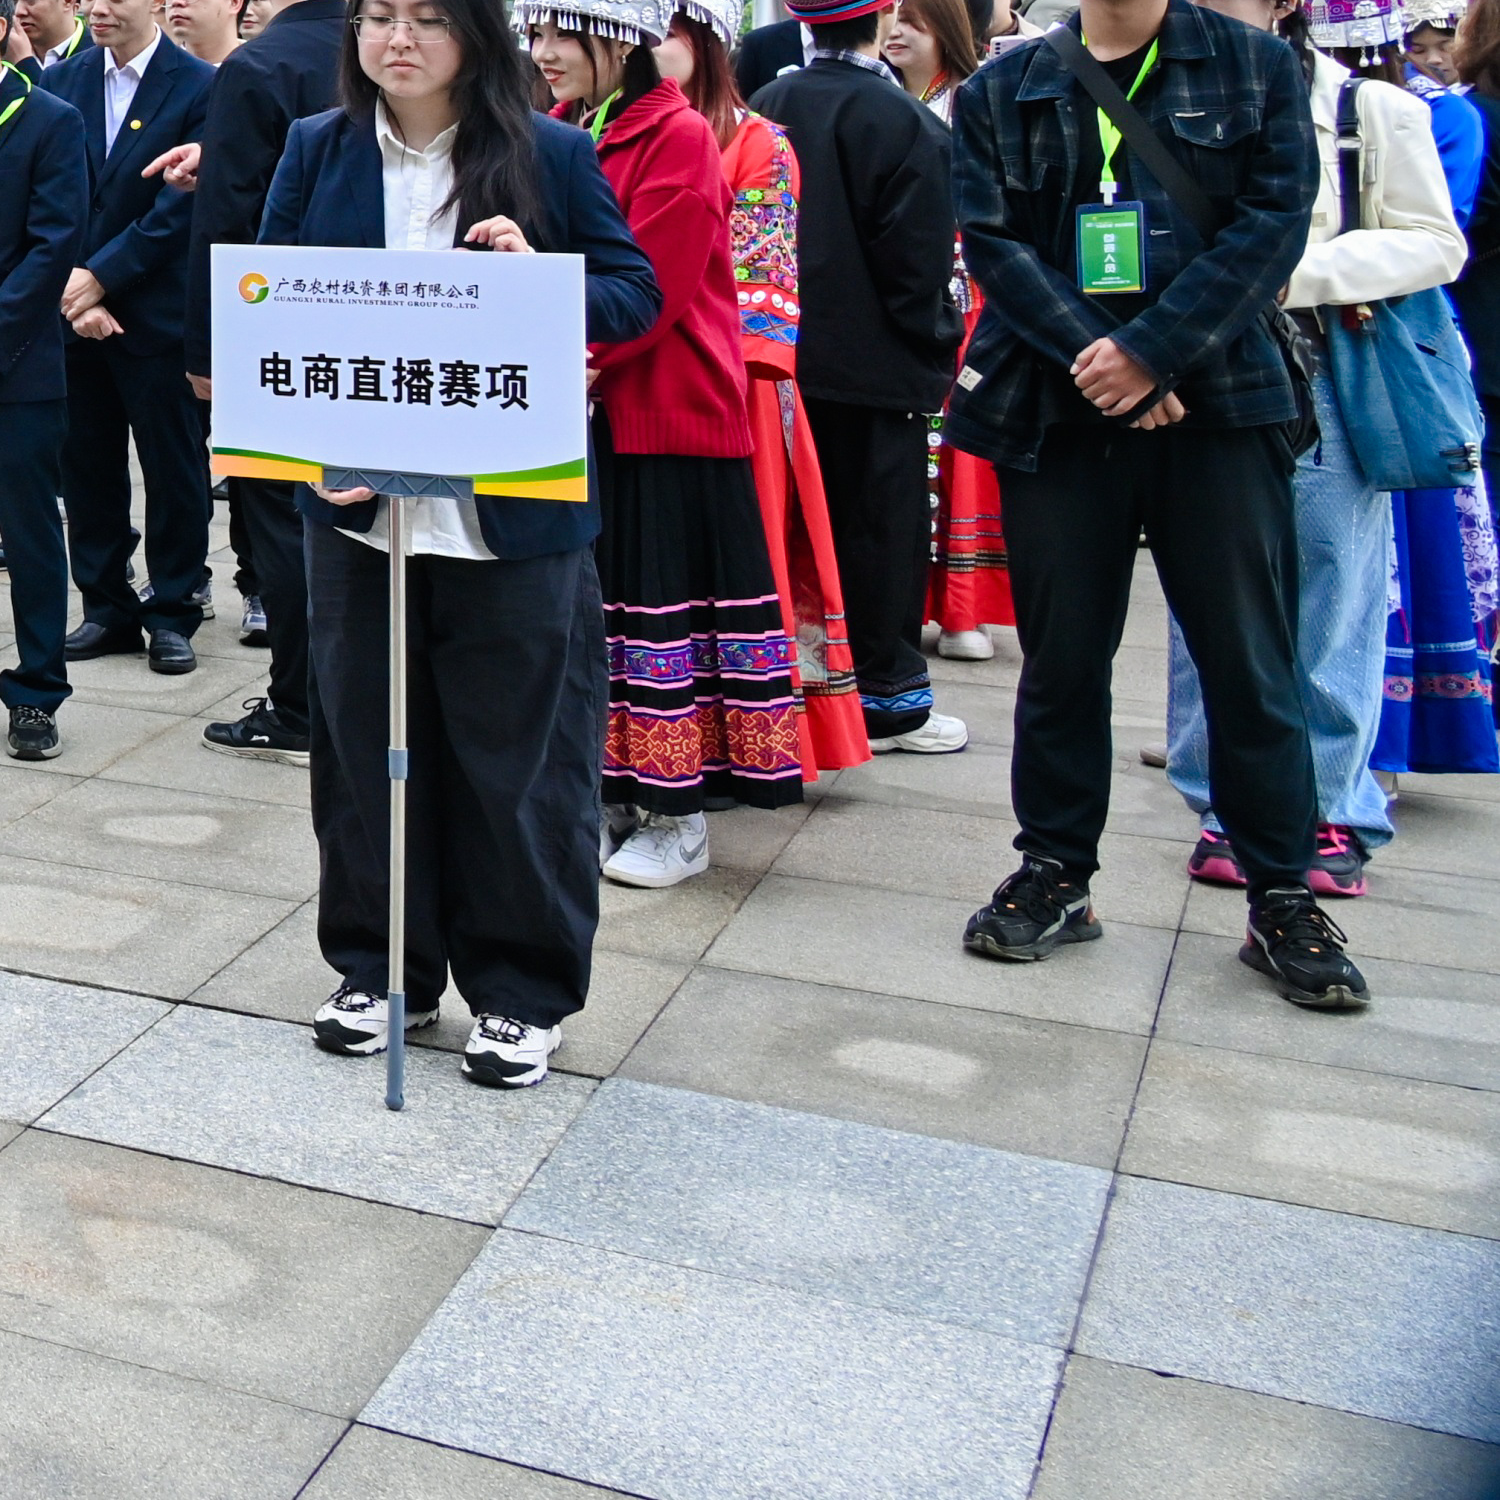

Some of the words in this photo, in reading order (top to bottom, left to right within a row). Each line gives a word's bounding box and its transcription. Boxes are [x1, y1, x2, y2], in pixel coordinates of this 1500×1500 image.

[274, 277, 479, 299] 广西农村投资集团有限公司
[348, 298, 404, 306] INVESTMENT
[259, 351, 530, 411] 电商直播赛项
